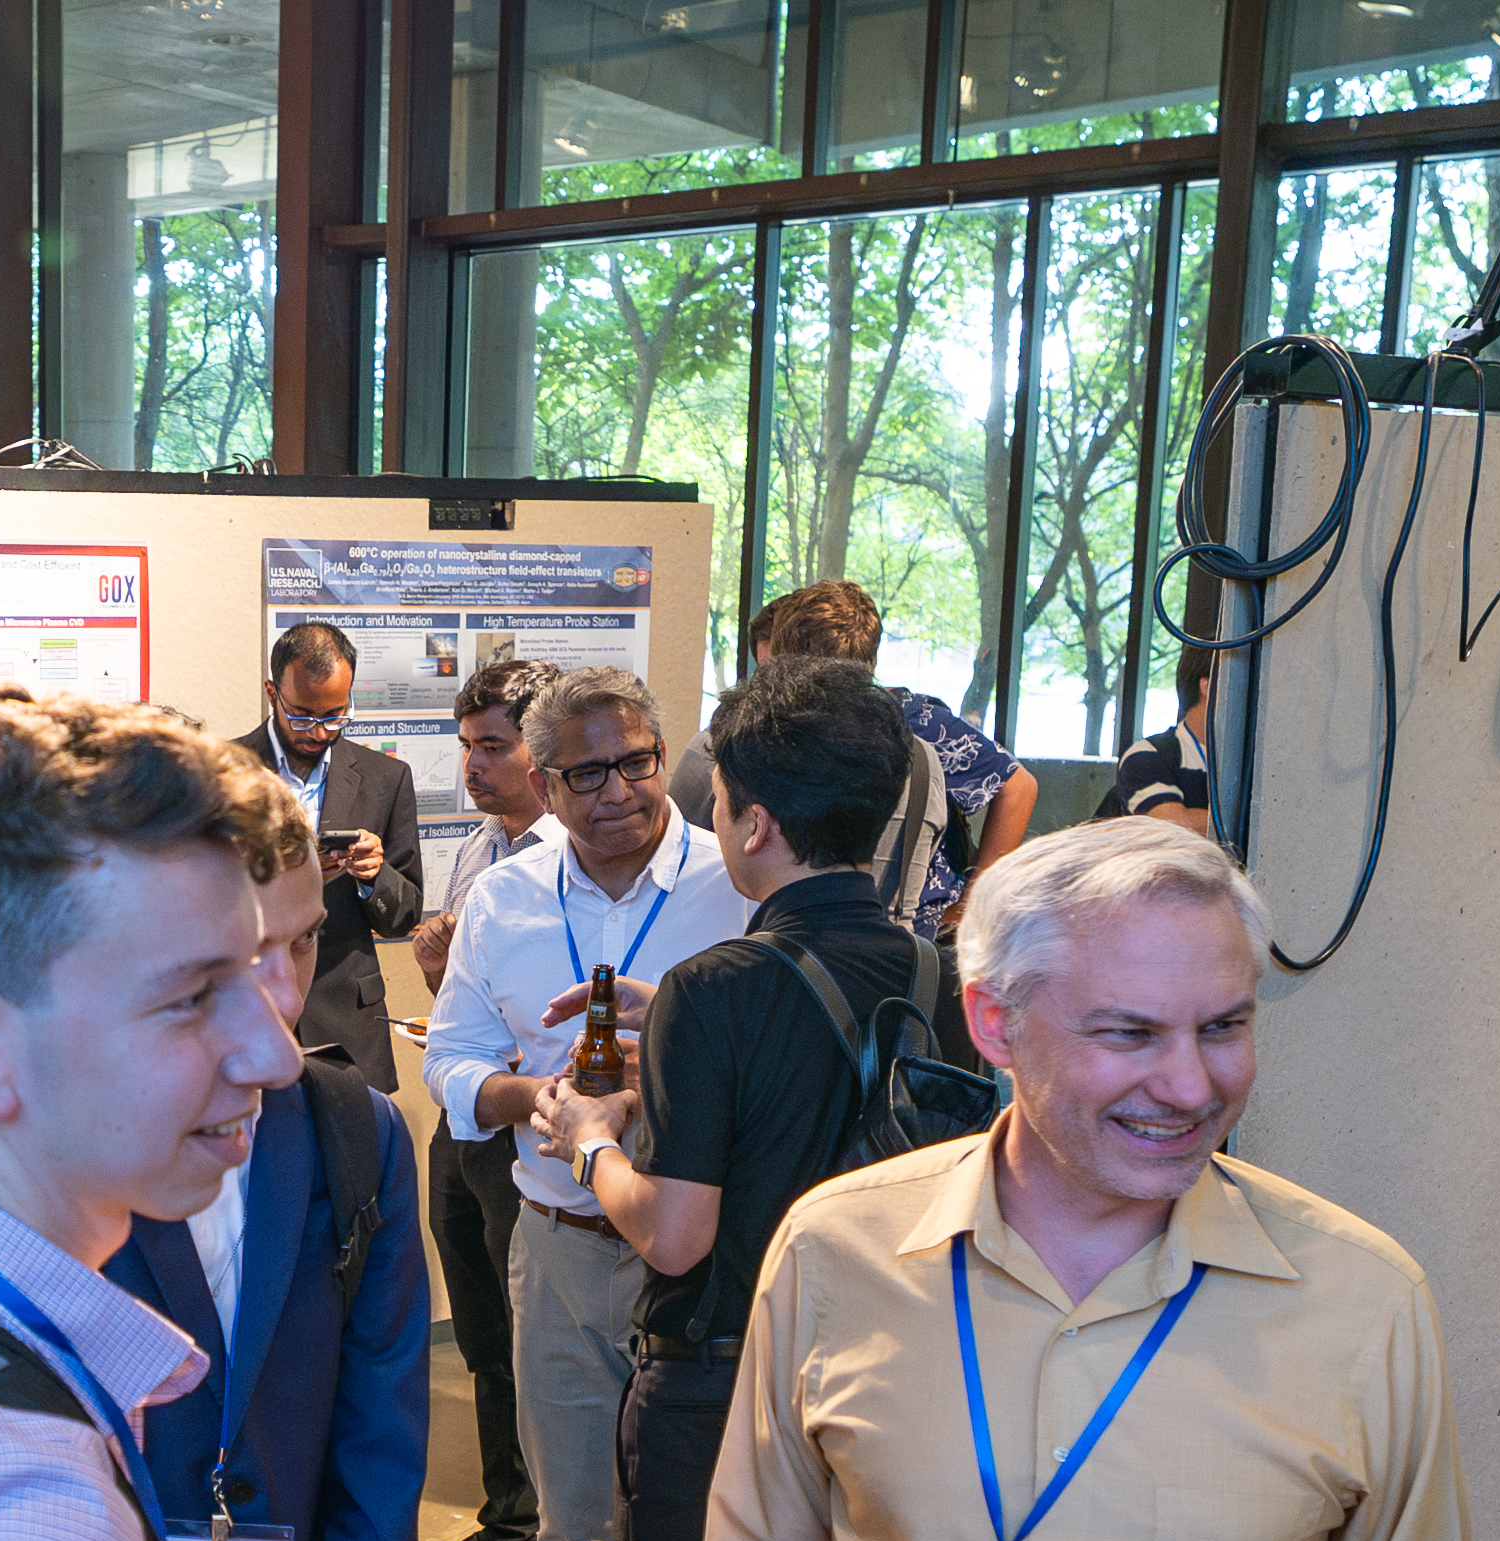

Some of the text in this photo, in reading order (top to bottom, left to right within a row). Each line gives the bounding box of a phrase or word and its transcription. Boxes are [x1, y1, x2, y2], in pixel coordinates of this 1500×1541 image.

[380, 548, 426, 562] operation
[427, 548, 438, 559] of
[438, 549, 507, 562] nanocrystalline
[509, 550, 582, 563] diamond-capped
[0, 560, 17, 570] and
[19, 560, 82, 571] Cost-Efficient
[436, 564, 602, 577] heterostructure field-effect transistors
[286, 568, 317, 578] NAVAL
[98, 574, 136, 603] GOX
[271, 579, 318, 588] RESEARCH
[271, 588, 317, 597] LABORATORY
[365, 615, 384, 627] and
[386, 615, 432, 627] Motivation
[483, 616, 620, 629] High Temperature Probe Station
[342, 722, 441, 736] ication and Structure
[429, 825, 466, 838] Isolation
